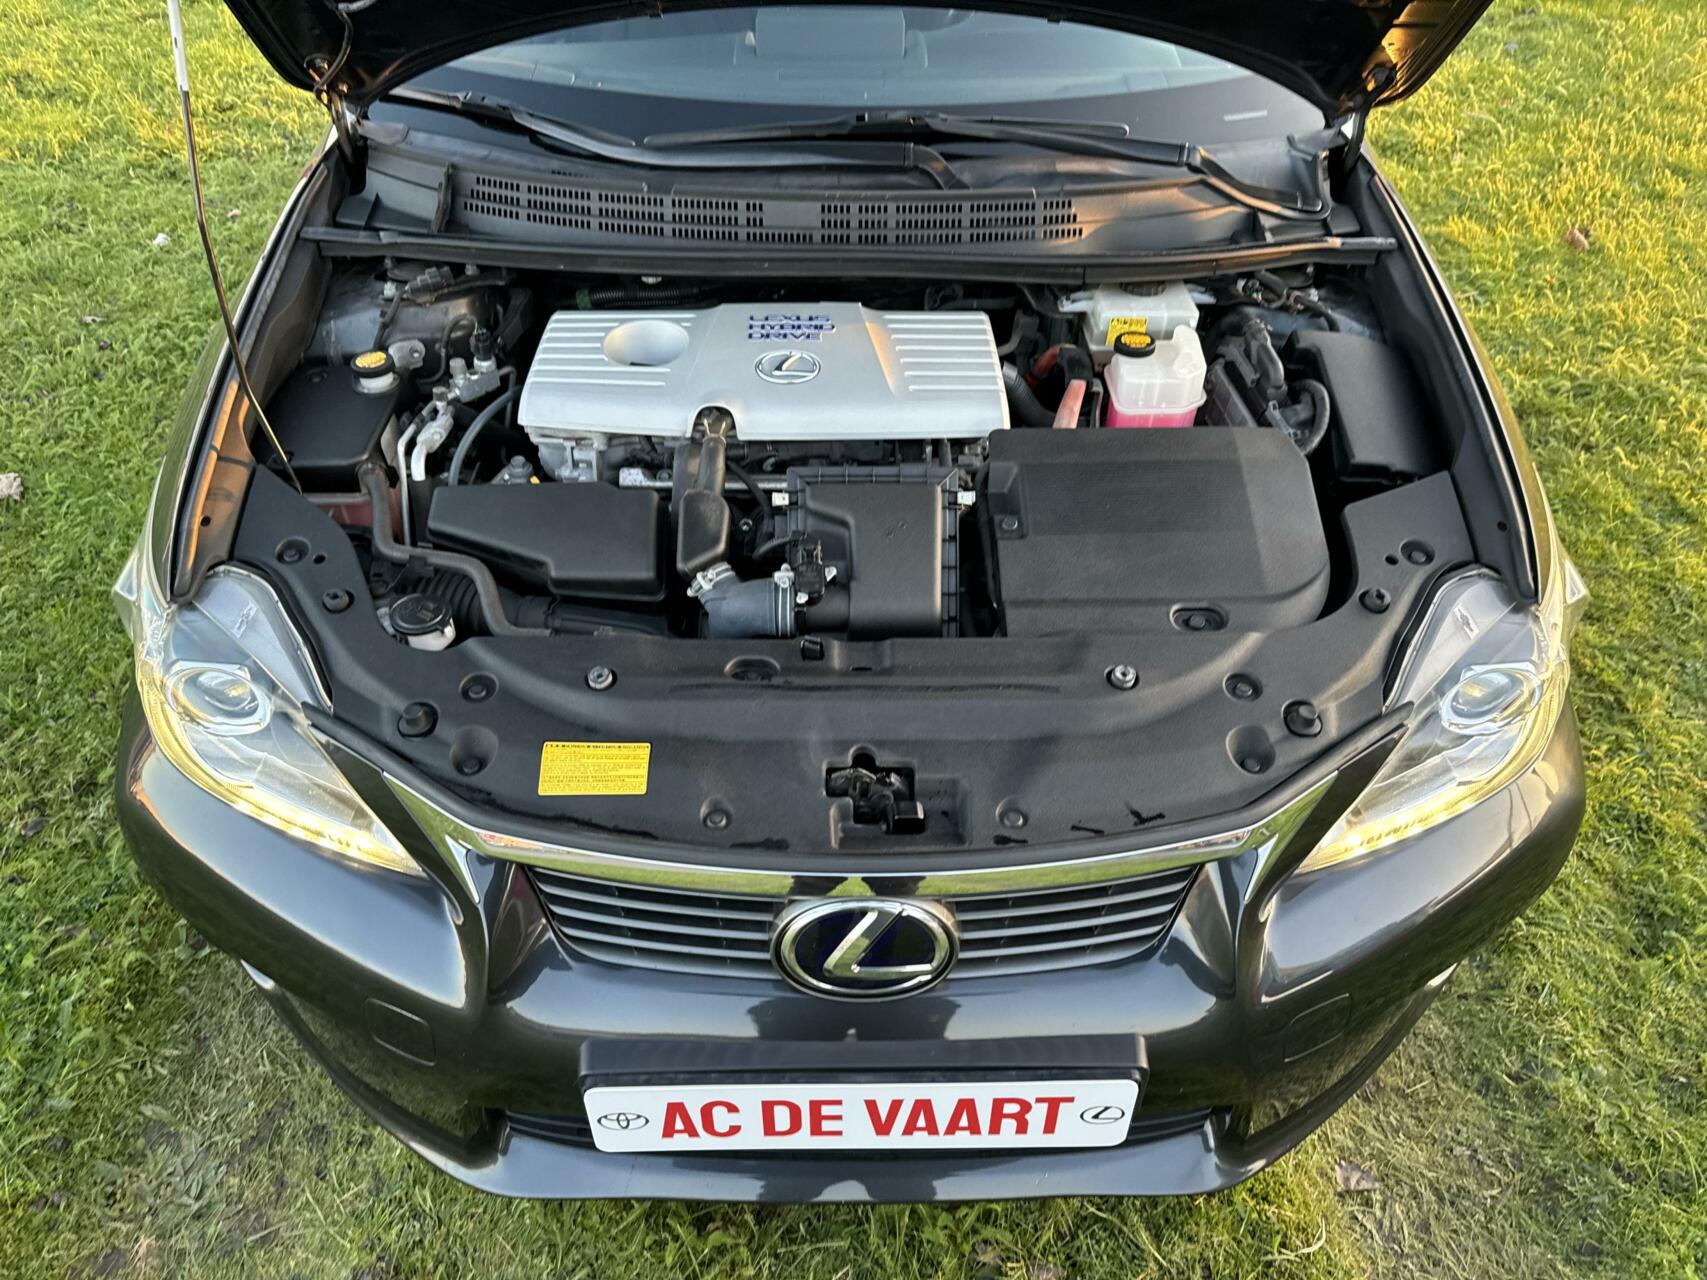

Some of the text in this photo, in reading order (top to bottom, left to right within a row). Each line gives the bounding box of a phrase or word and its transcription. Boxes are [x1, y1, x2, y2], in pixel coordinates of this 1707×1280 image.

[748, 314, 830, 323] LEXUS
[748, 323, 835, 332] HYBRID
[748, 332, 821, 341] DRIVE
[662, 1096, 1075, 1139] AC DE VAART
